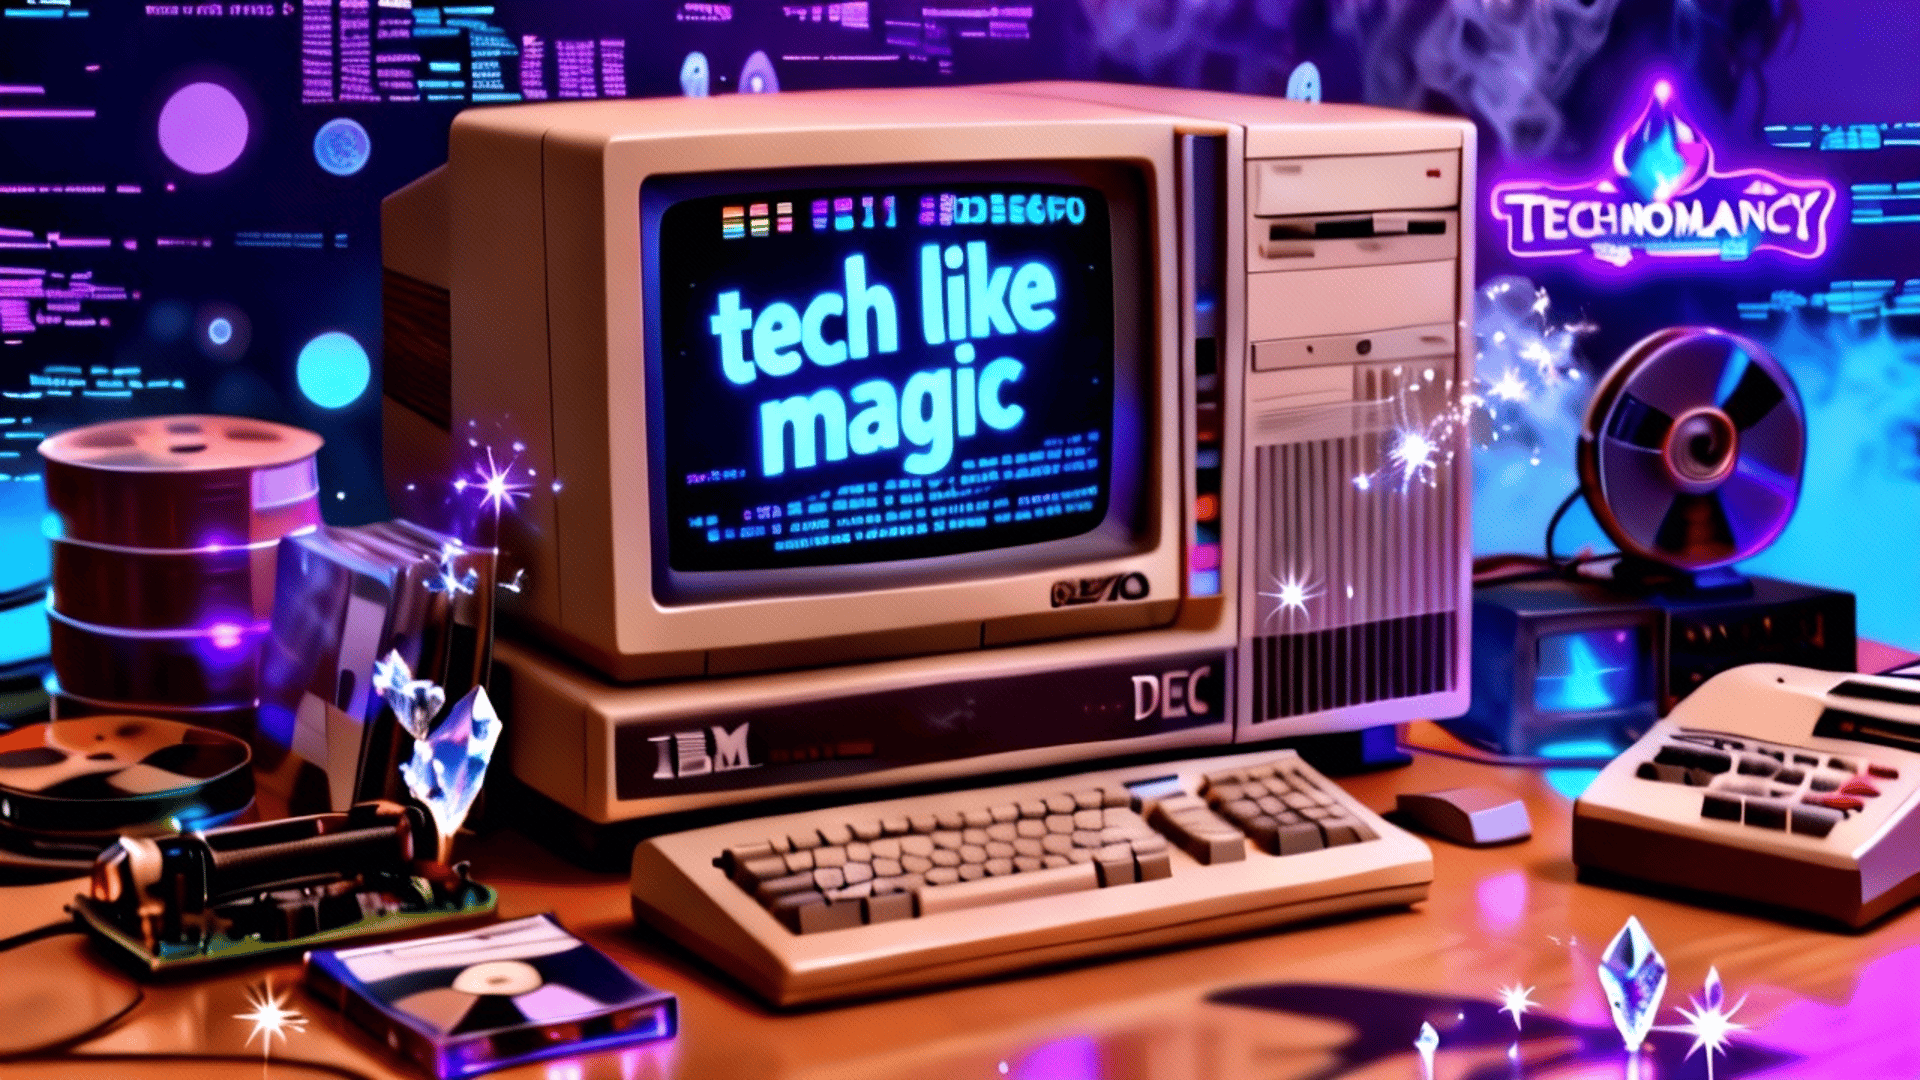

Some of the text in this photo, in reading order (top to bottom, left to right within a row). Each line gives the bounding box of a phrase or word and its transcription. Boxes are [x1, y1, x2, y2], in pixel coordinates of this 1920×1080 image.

[1504, 190, 1822, 243] TECHNOMANCY
[710, 240, 1058, 385] tech like
[760, 342, 1025, 477] magic
[1131, 665, 1211, 721] DEC
[647, 722, 750, 779] IBM
